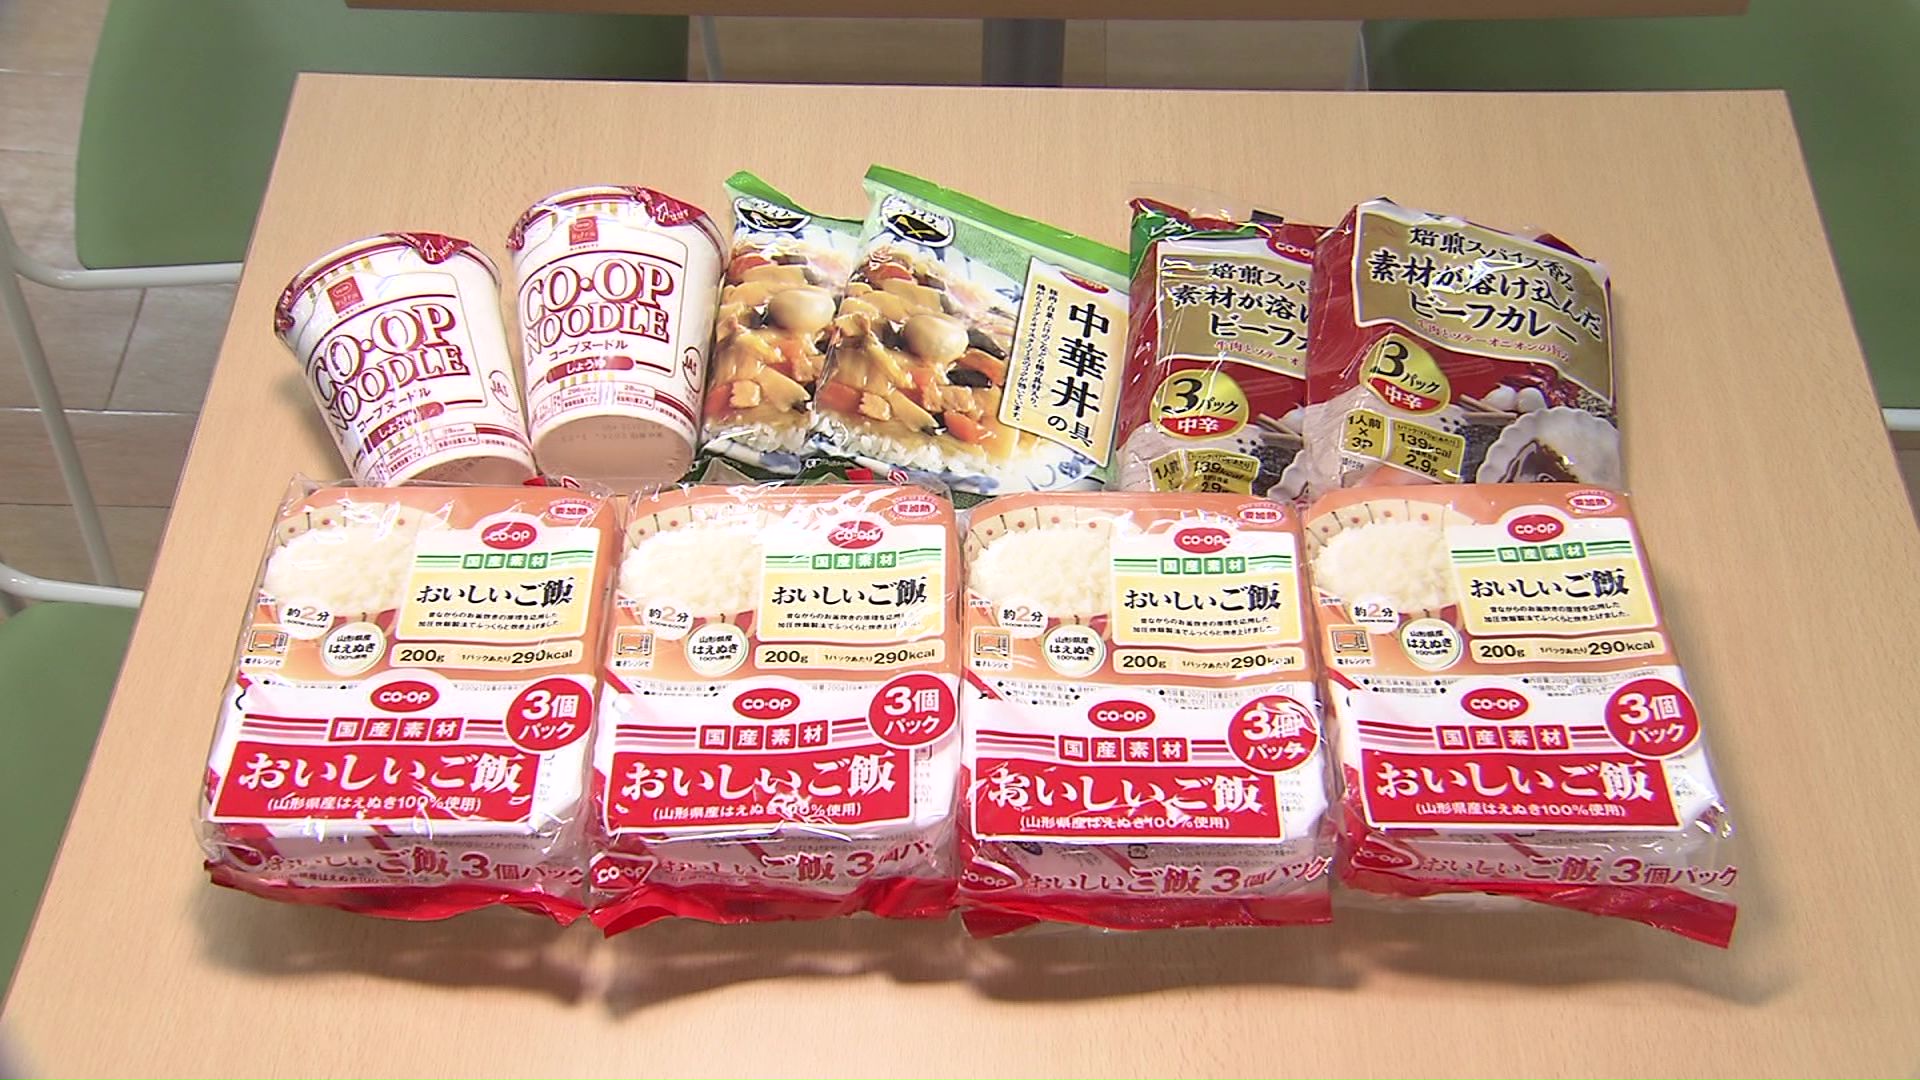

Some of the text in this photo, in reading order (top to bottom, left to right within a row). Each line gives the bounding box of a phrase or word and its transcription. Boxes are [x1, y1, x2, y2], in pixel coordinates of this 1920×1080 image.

[1368, 250, 1602, 341] 素材が溶け込んだ
[1410, 289, 1577, 344] ビーフカレー
[525, 302, 670, 366] NOODLE
[548, 338, 628, 362] コープヌードル
[566, 357, 606, 374] しょうゆ
[1047, 303, 1110, 447] 中華丼の具
[1385, 384, 1423, 409] 中辛
[357, 388, 431, 433] コープヌードル
[1178, 417, 1220, 434] 中辛
[1347, 415, 1382, 429] 1人前
[416, 577, 573, 608] おいしいご飯
[771, 576, 926, 605] おいしいご飯
[1470, 568, 1629, 599] おいしいご飯
[1124, 582, 1280, 612] おいしいご飯
[286, 606, 330, 622] 約2分
[648, 606, 689, 622] 約2分
[1003, 606, 1043, 622] 約2分
[1354, 603, 1393, 618] 約2分
[328, 643, 376, 654] はえぬき
[692, 644, 739, 655] はえぬき
[1049, 645, 1096, 655] はえぬき
[1406, 638, 1452, 649] はえぬき
[1480, 645, 1525, 658] 200g
[400, 649, 445, 662] 200g
[765, 650, 808, 664] 200g
[1122, 655, 1167, 668] 200g
[521, 690, 579, 720] 3個
[883, 687, 940, 713] 3個
[1619, 695, 1682, 723] 3個
[335, 720, 459, 739] 国産素材
[518, 724, 574, 741] パック
[703, 722, 826, 746] 国産素材
[884, 716, 940, 735] パック
[1440, 728, 1564, 748] 国産素材
[1627, 727, 1685, 746] パック
[1063, 740, 1183, 758] 国産素材
[237, 750, 528, 794] おいしいご飯
[621, 750, 895, 801] おいしいご飯
[1376, 761, 1654, 801] おいしいご飯
[268, 792, 482, 812] (山形県産はえぬき100%使用)
[985, 773, 1262, 813] おいしいご飯
[1416, 802, 1626, 817] (山形県産はえぬき100%使用)
[1610, 858, 1738, 887] 3個パック
